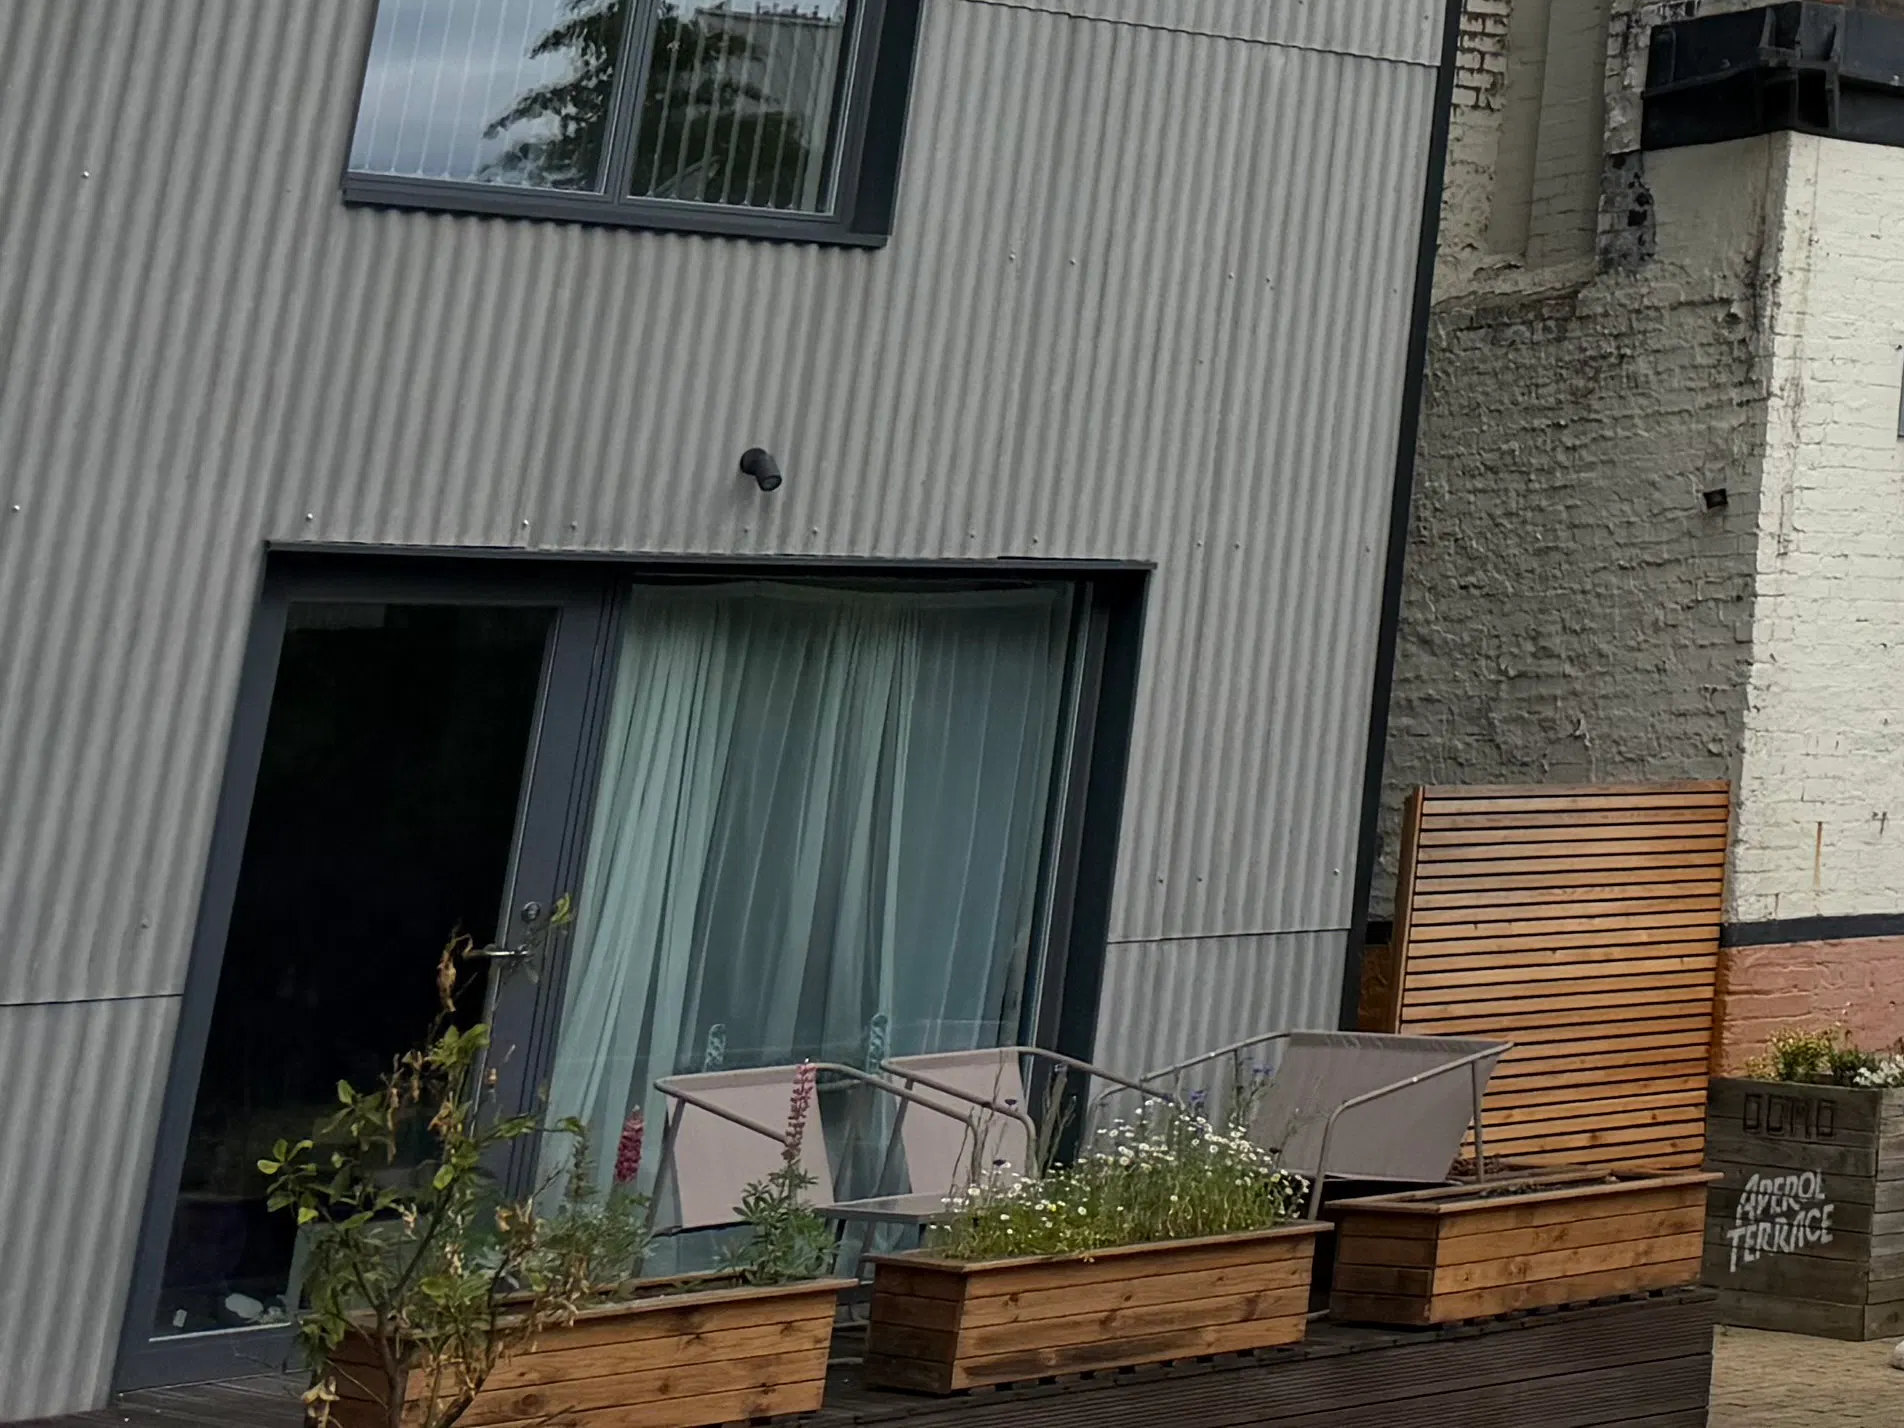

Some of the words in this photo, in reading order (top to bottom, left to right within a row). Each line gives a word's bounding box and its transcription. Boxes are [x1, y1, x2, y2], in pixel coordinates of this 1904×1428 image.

[1742, 1093, 1838, 1141] DOMO
[1735, 1167, 1826, 1227] APEROL
[1726, 1203, 1835, 1273] TERRACE
